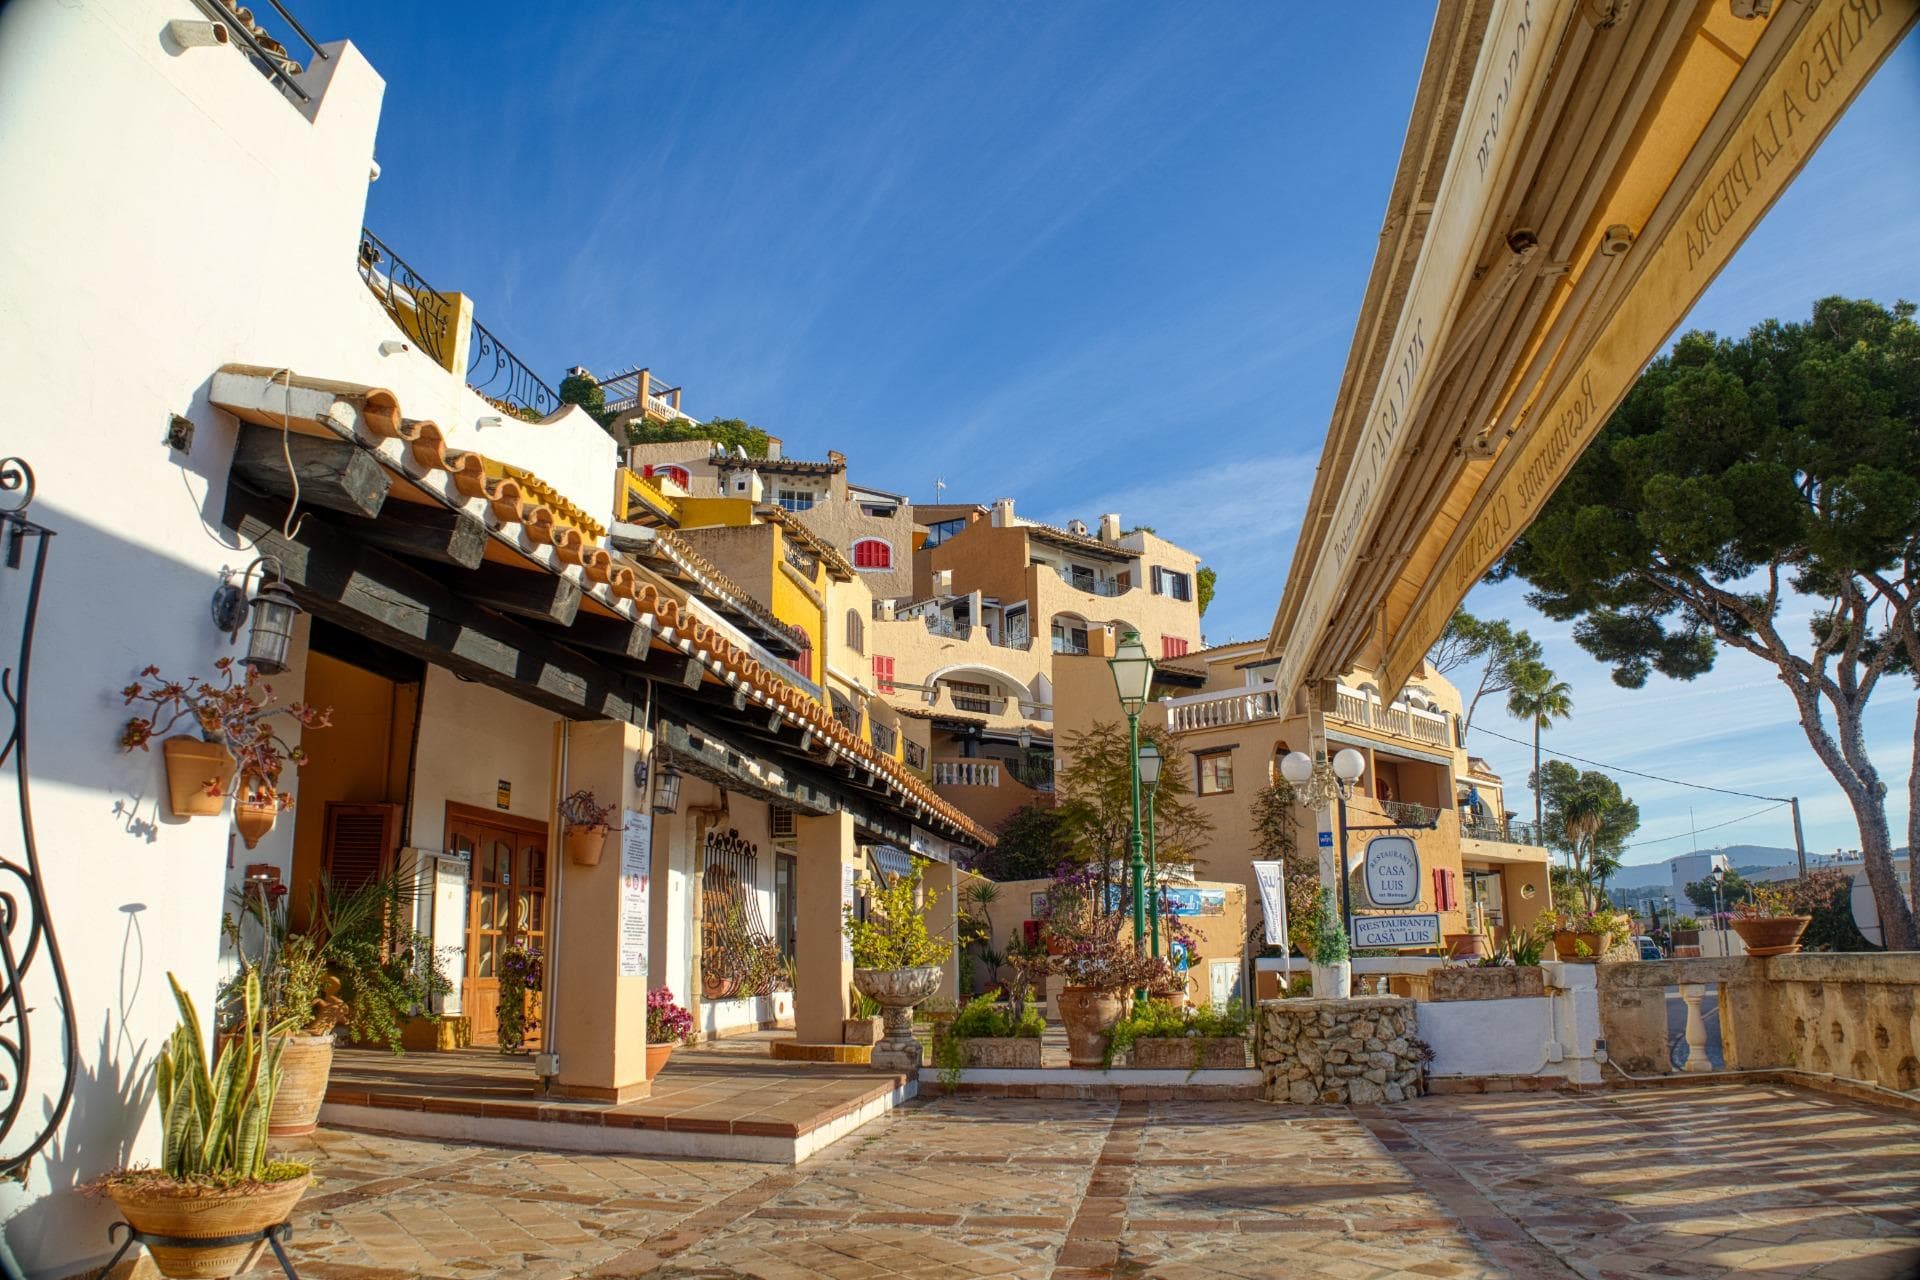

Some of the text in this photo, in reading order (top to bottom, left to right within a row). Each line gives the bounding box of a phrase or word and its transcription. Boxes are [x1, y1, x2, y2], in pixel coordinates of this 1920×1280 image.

[1370, 849, 1415, 869] RESTAURANTE
[1379, 864, 1405, 876] CASA
[1381, 880, 1404, 891] LUIS
[1359, 918, 1436, 932] RESTAURANTE
[1367, 930, 1429, 944] CASA LUIS
